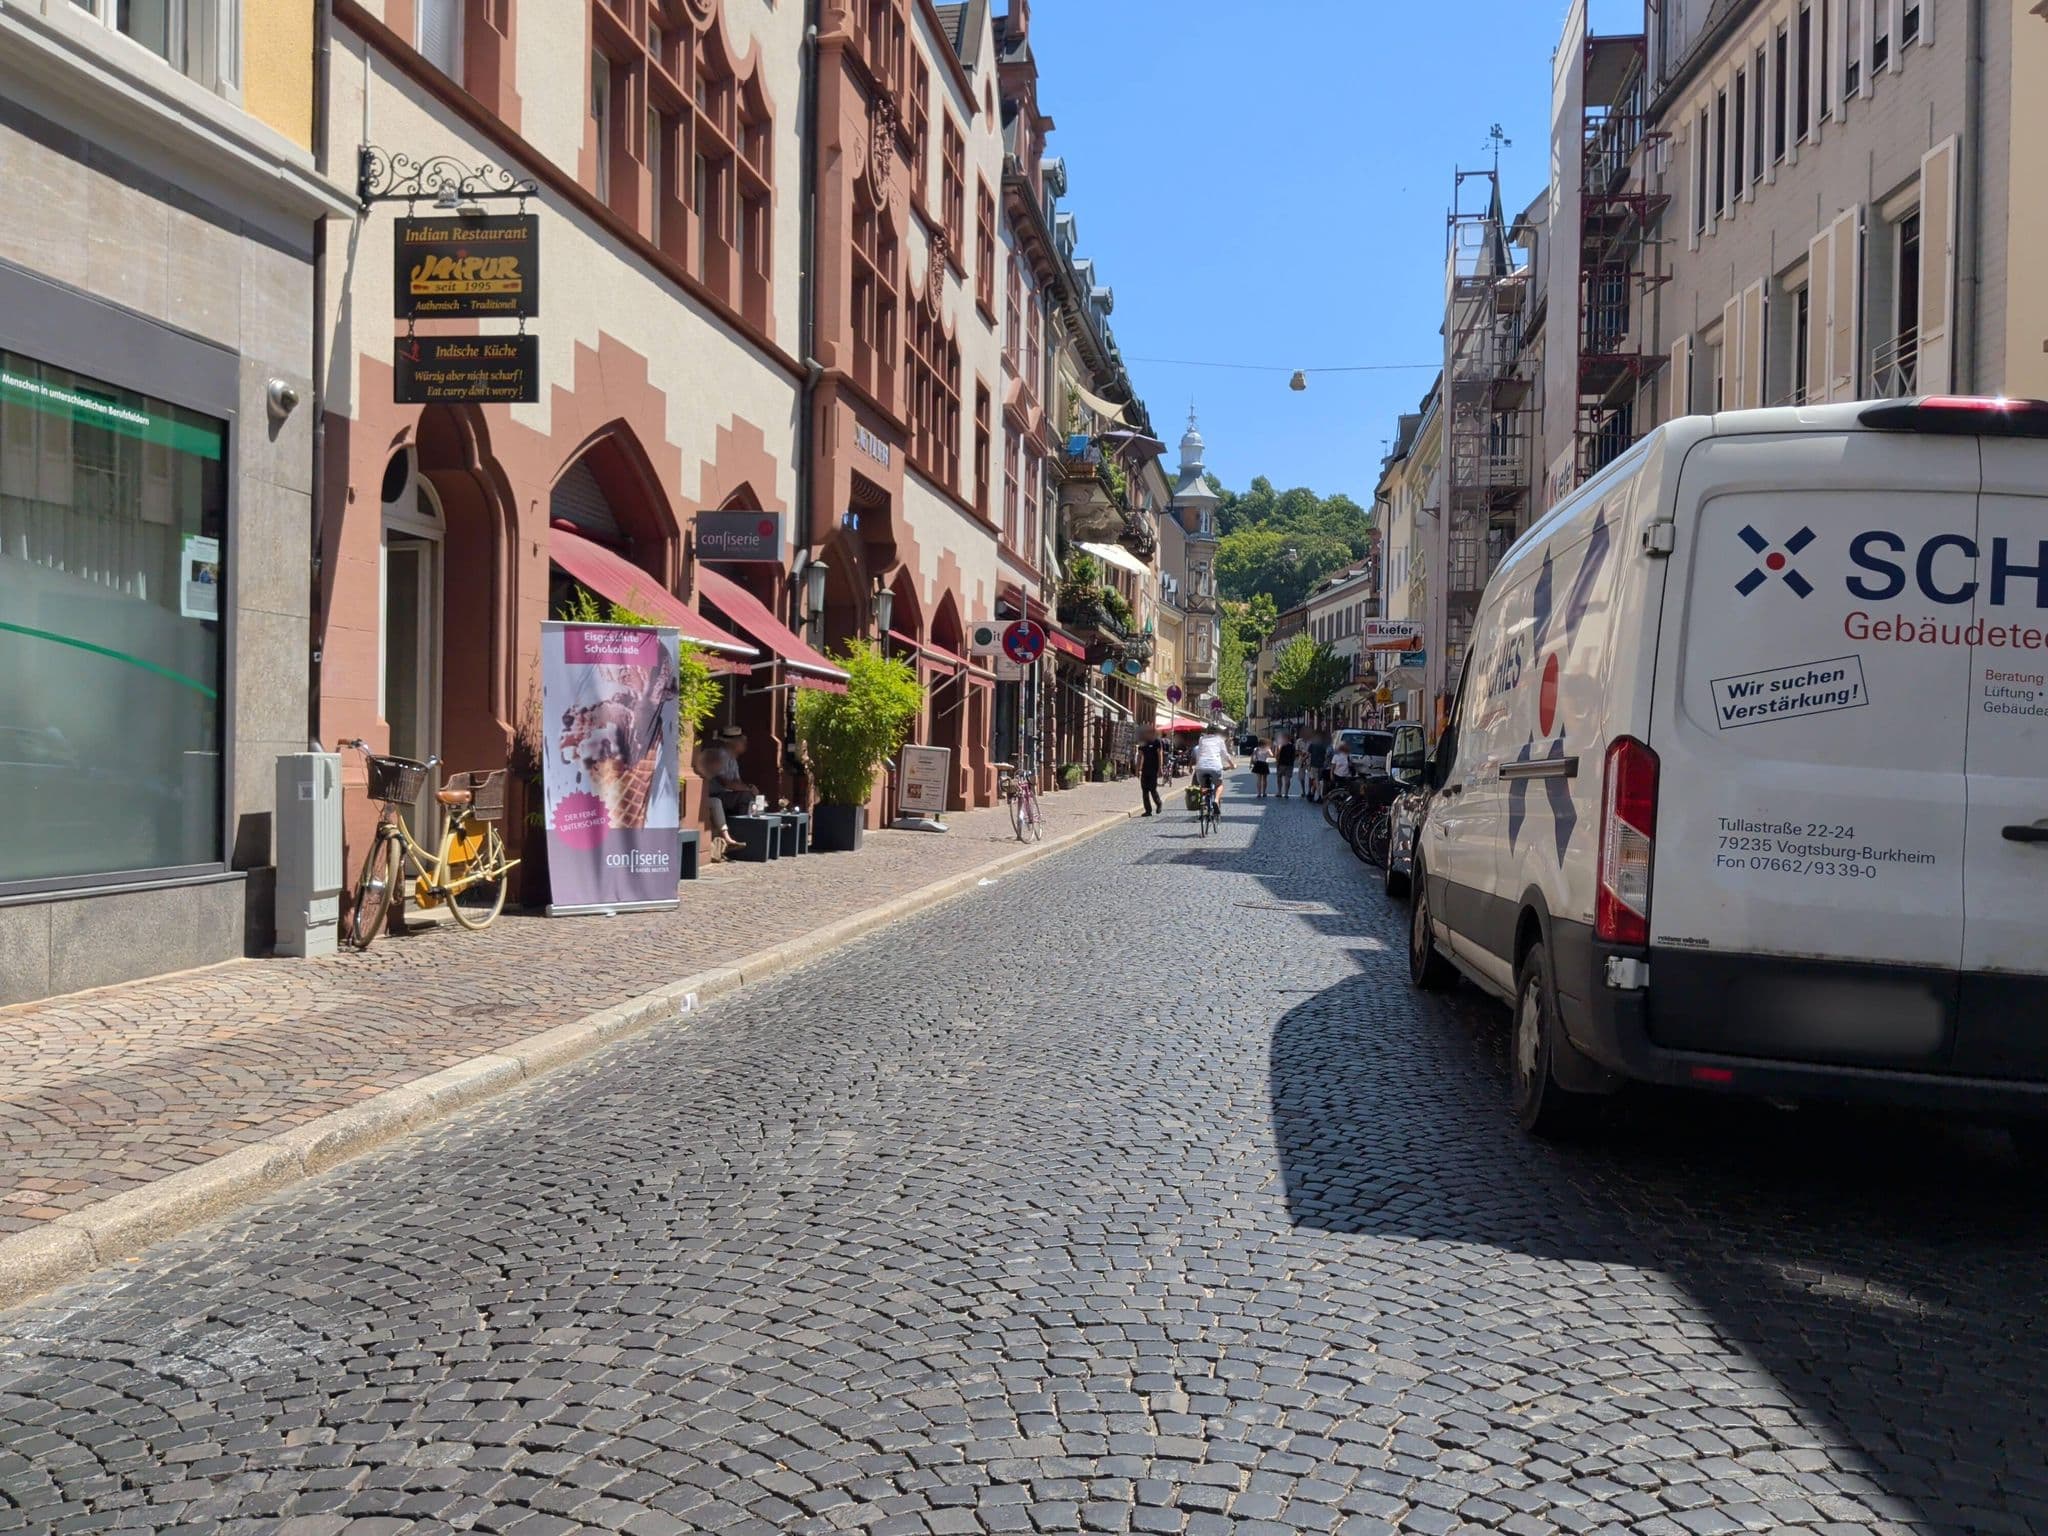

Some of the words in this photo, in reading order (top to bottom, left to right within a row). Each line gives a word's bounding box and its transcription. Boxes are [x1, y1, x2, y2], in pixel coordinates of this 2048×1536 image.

[405, 226, 449, 242] Indian
[452, 226, 528, 241] Restaurant
[435, 281, 457, 292] seit
[465, 281, 492, 292] 1995
[436, 344, 479, 358] Indische
[483, 344, 517, 357] Küche
[415, 371, 445, 384] Würzig
[446, 370, 466, 381] aber
[467, 369, 489, 381] nicht
[2, 373, 40, 393] Menschen
[40, 384, 49, 396] in
[49, 390, 108, 414] unterschiedlichen
[427, 386, 443, 396] Eat
[444, 387, 467, 399] curry
[701, 530, 760, 552] confiserie
[1379, 624, 1413, 635] kiefer
[1844, 611, 2048, 649] Gebäudete
[584, 643, 640, 655] Schokolade
[1727, 680, 1765, 699] Wir
[1770, 669, 1845, 692] suchen
[1985, 669, 2044, 686] Beratung
[1984, 685, 2034, 701] Lüftung
[1722, 683, 1859, 721] Verstärkung!
[1718, 817, 1803, 836] Tullastraße
[1806, 823, 1856, 840] 22-24
[1718, 836, 1772, 852] 79235
[1777, 839, 1936, 865] Vogtsburg-Burkheim
[606, 848, 670, 873] confiserie
[1716, 854, 1745, 869] Fon
